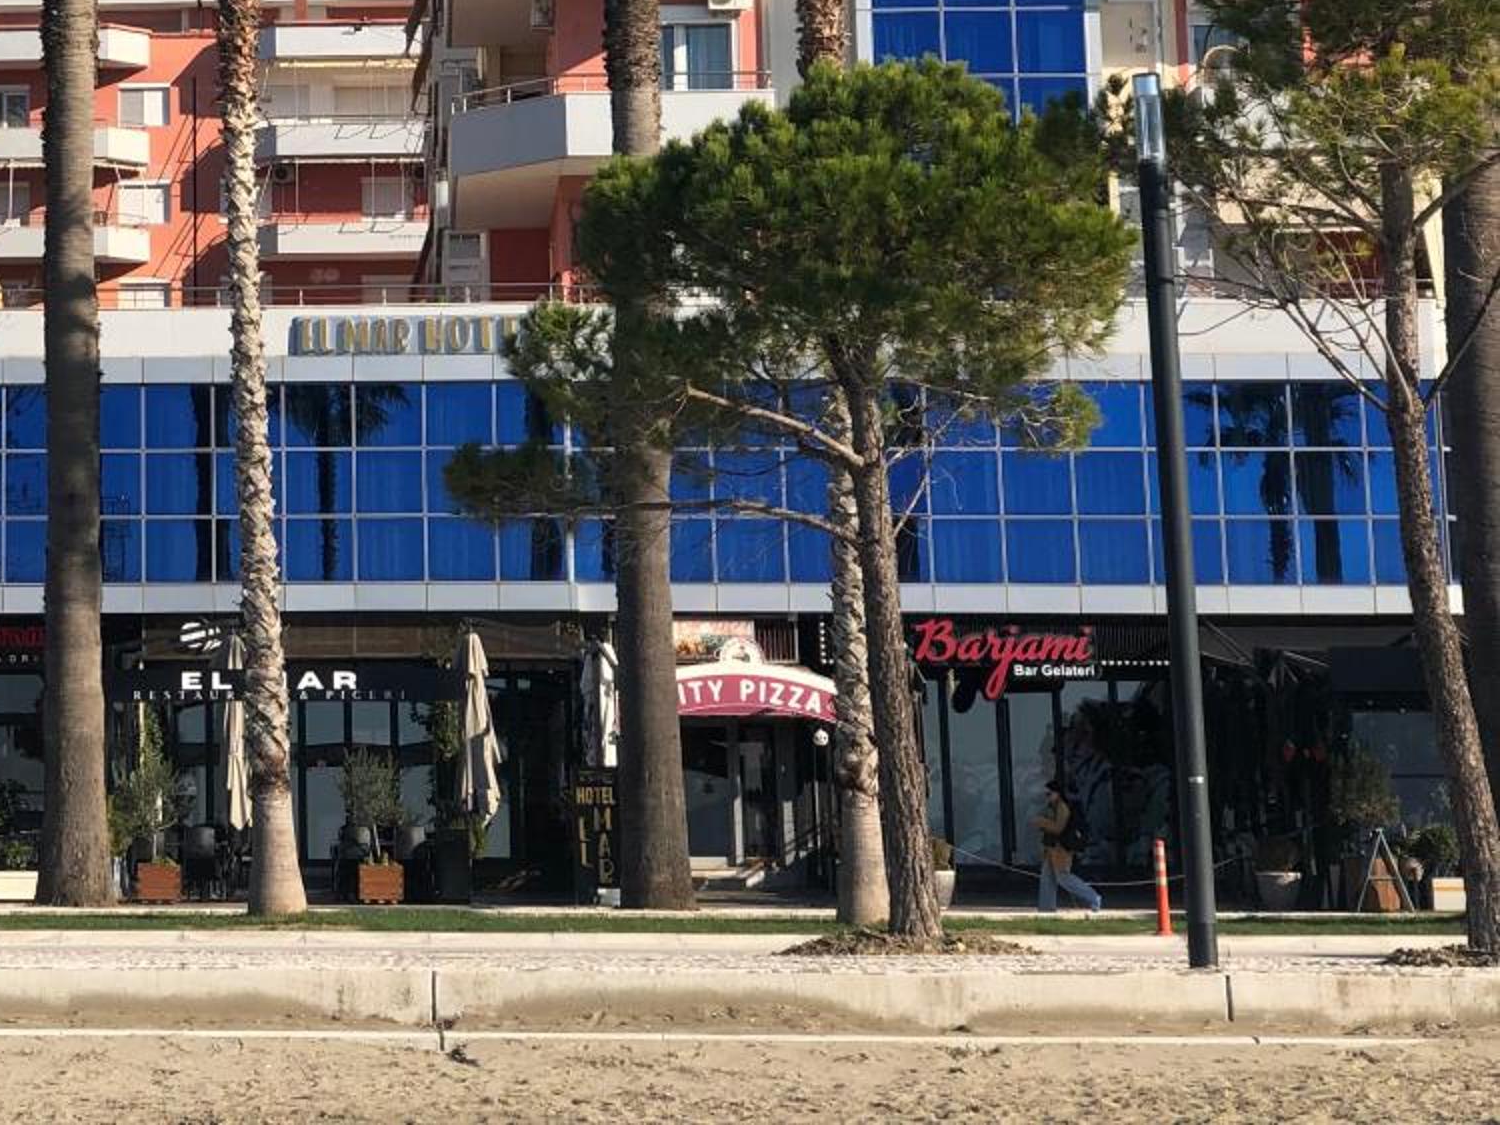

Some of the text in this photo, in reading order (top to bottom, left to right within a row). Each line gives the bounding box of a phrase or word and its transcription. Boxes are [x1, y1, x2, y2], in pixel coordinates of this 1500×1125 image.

[911, 619, 1096, 700] Barjami
[1013, 663, 1096, 676] Bar Gelateri
[181, 671, 358, 690] EL AR
[133, 690, 250, 700] RESTAUR
[299, 690, 309, 700] &
[677, 678, 822, 714] ITY PIZZA
[576, 786, 616, 803] HOTEL
